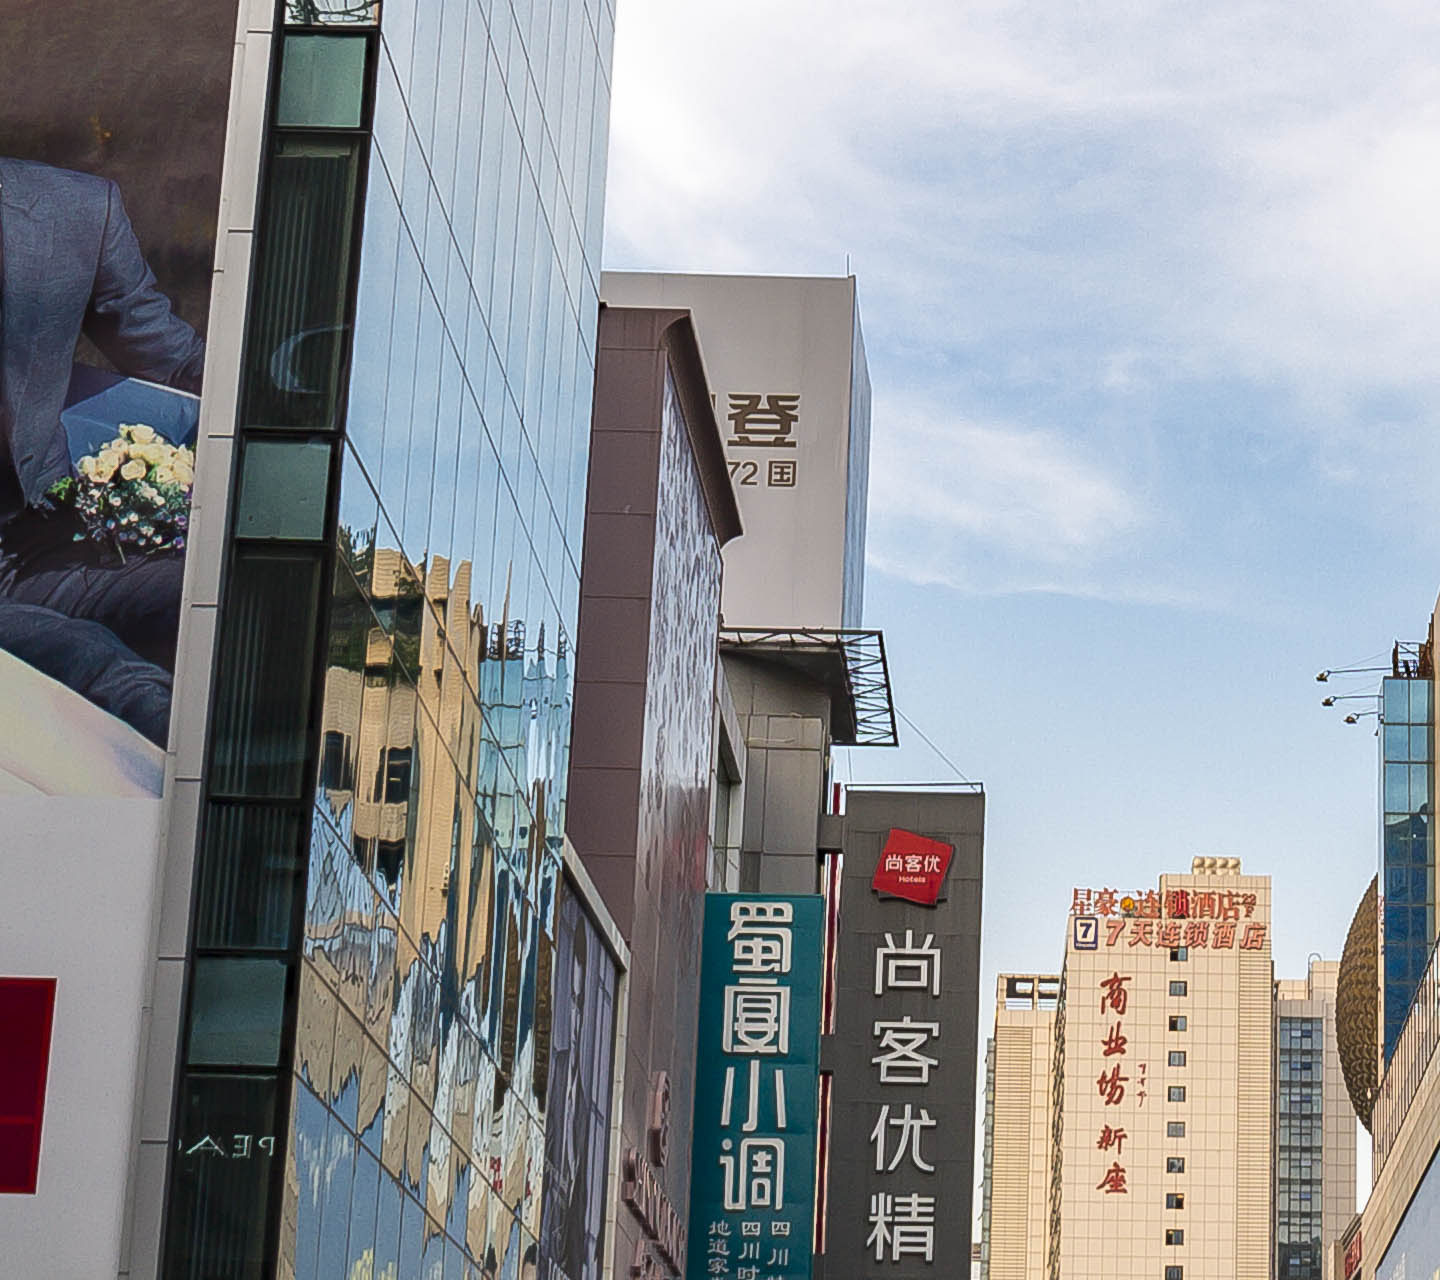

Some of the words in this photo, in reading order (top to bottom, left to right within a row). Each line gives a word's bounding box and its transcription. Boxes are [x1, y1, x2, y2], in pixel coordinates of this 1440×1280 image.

[885, 853, 942, 873] 尚客优
[898, 874, 926, 884] Hotels
